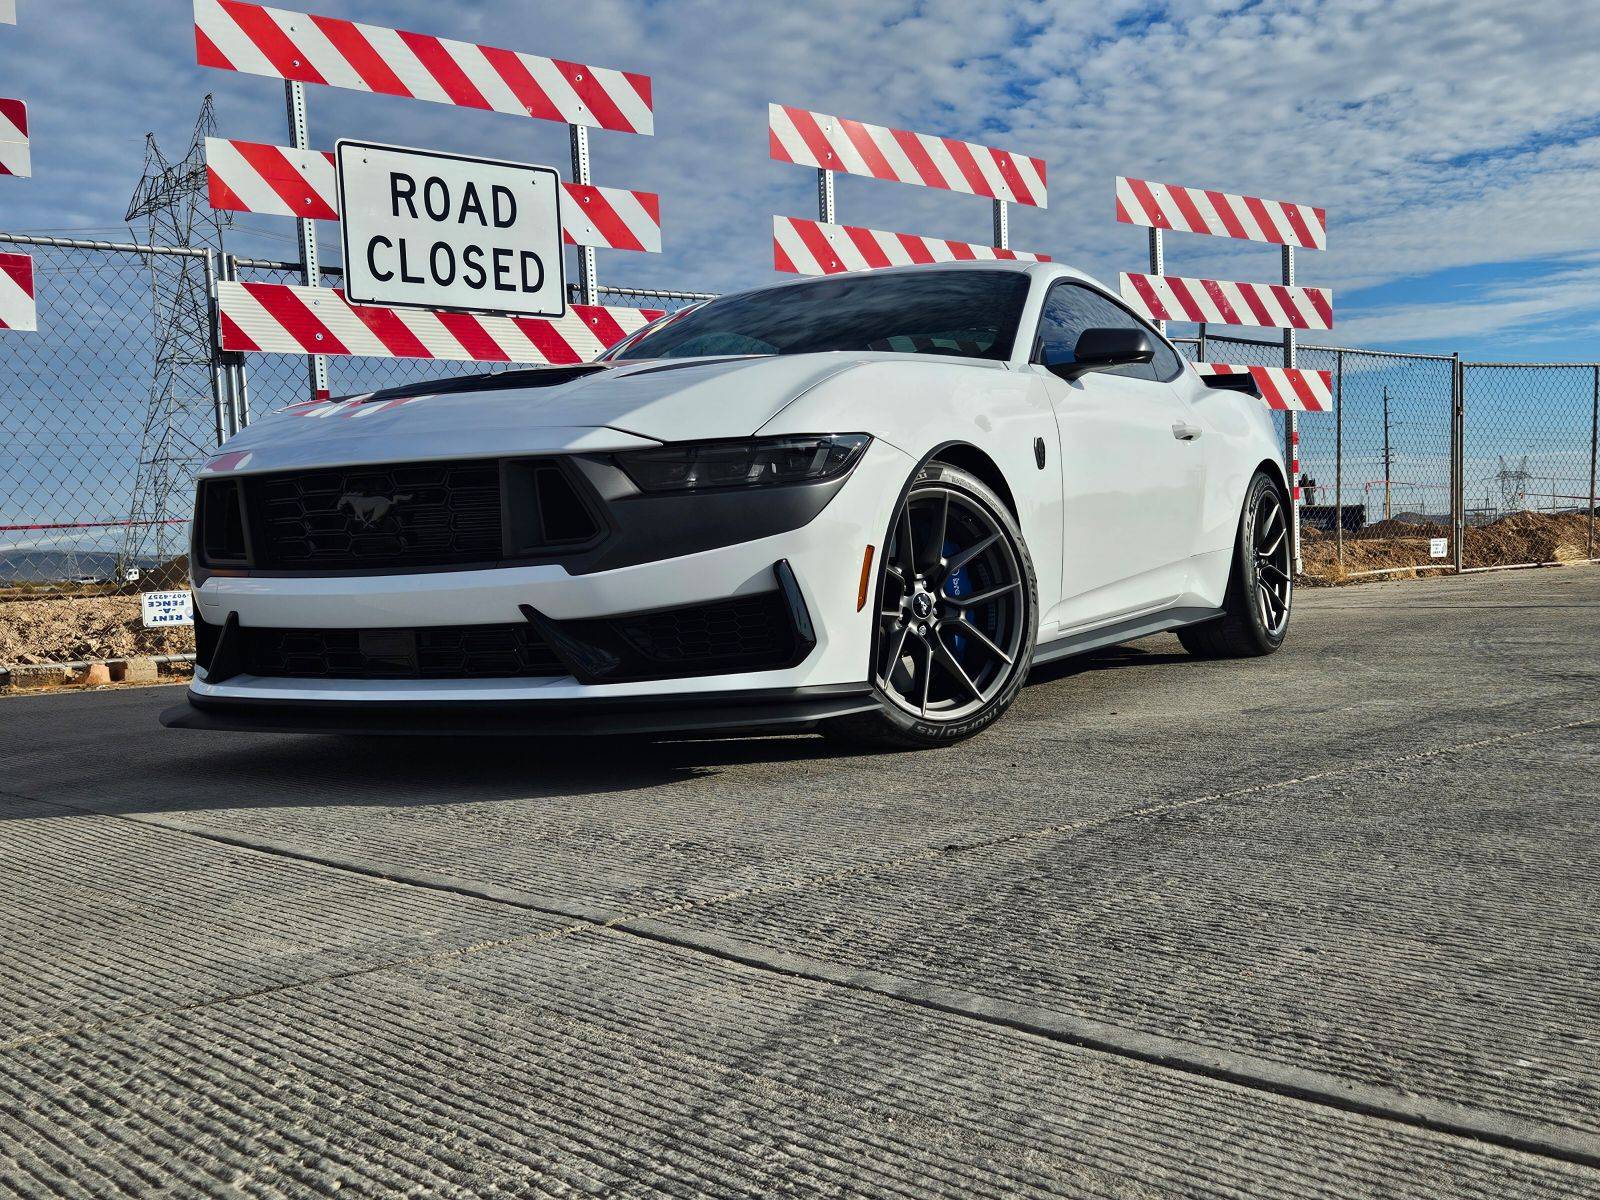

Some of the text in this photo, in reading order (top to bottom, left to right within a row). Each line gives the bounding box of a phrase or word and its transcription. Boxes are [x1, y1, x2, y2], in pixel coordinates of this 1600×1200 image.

[389, 171, 517, 228] ROAD
[366, 234, 545, 294] CLOSED
[152, 614, 183, 622] RENT
